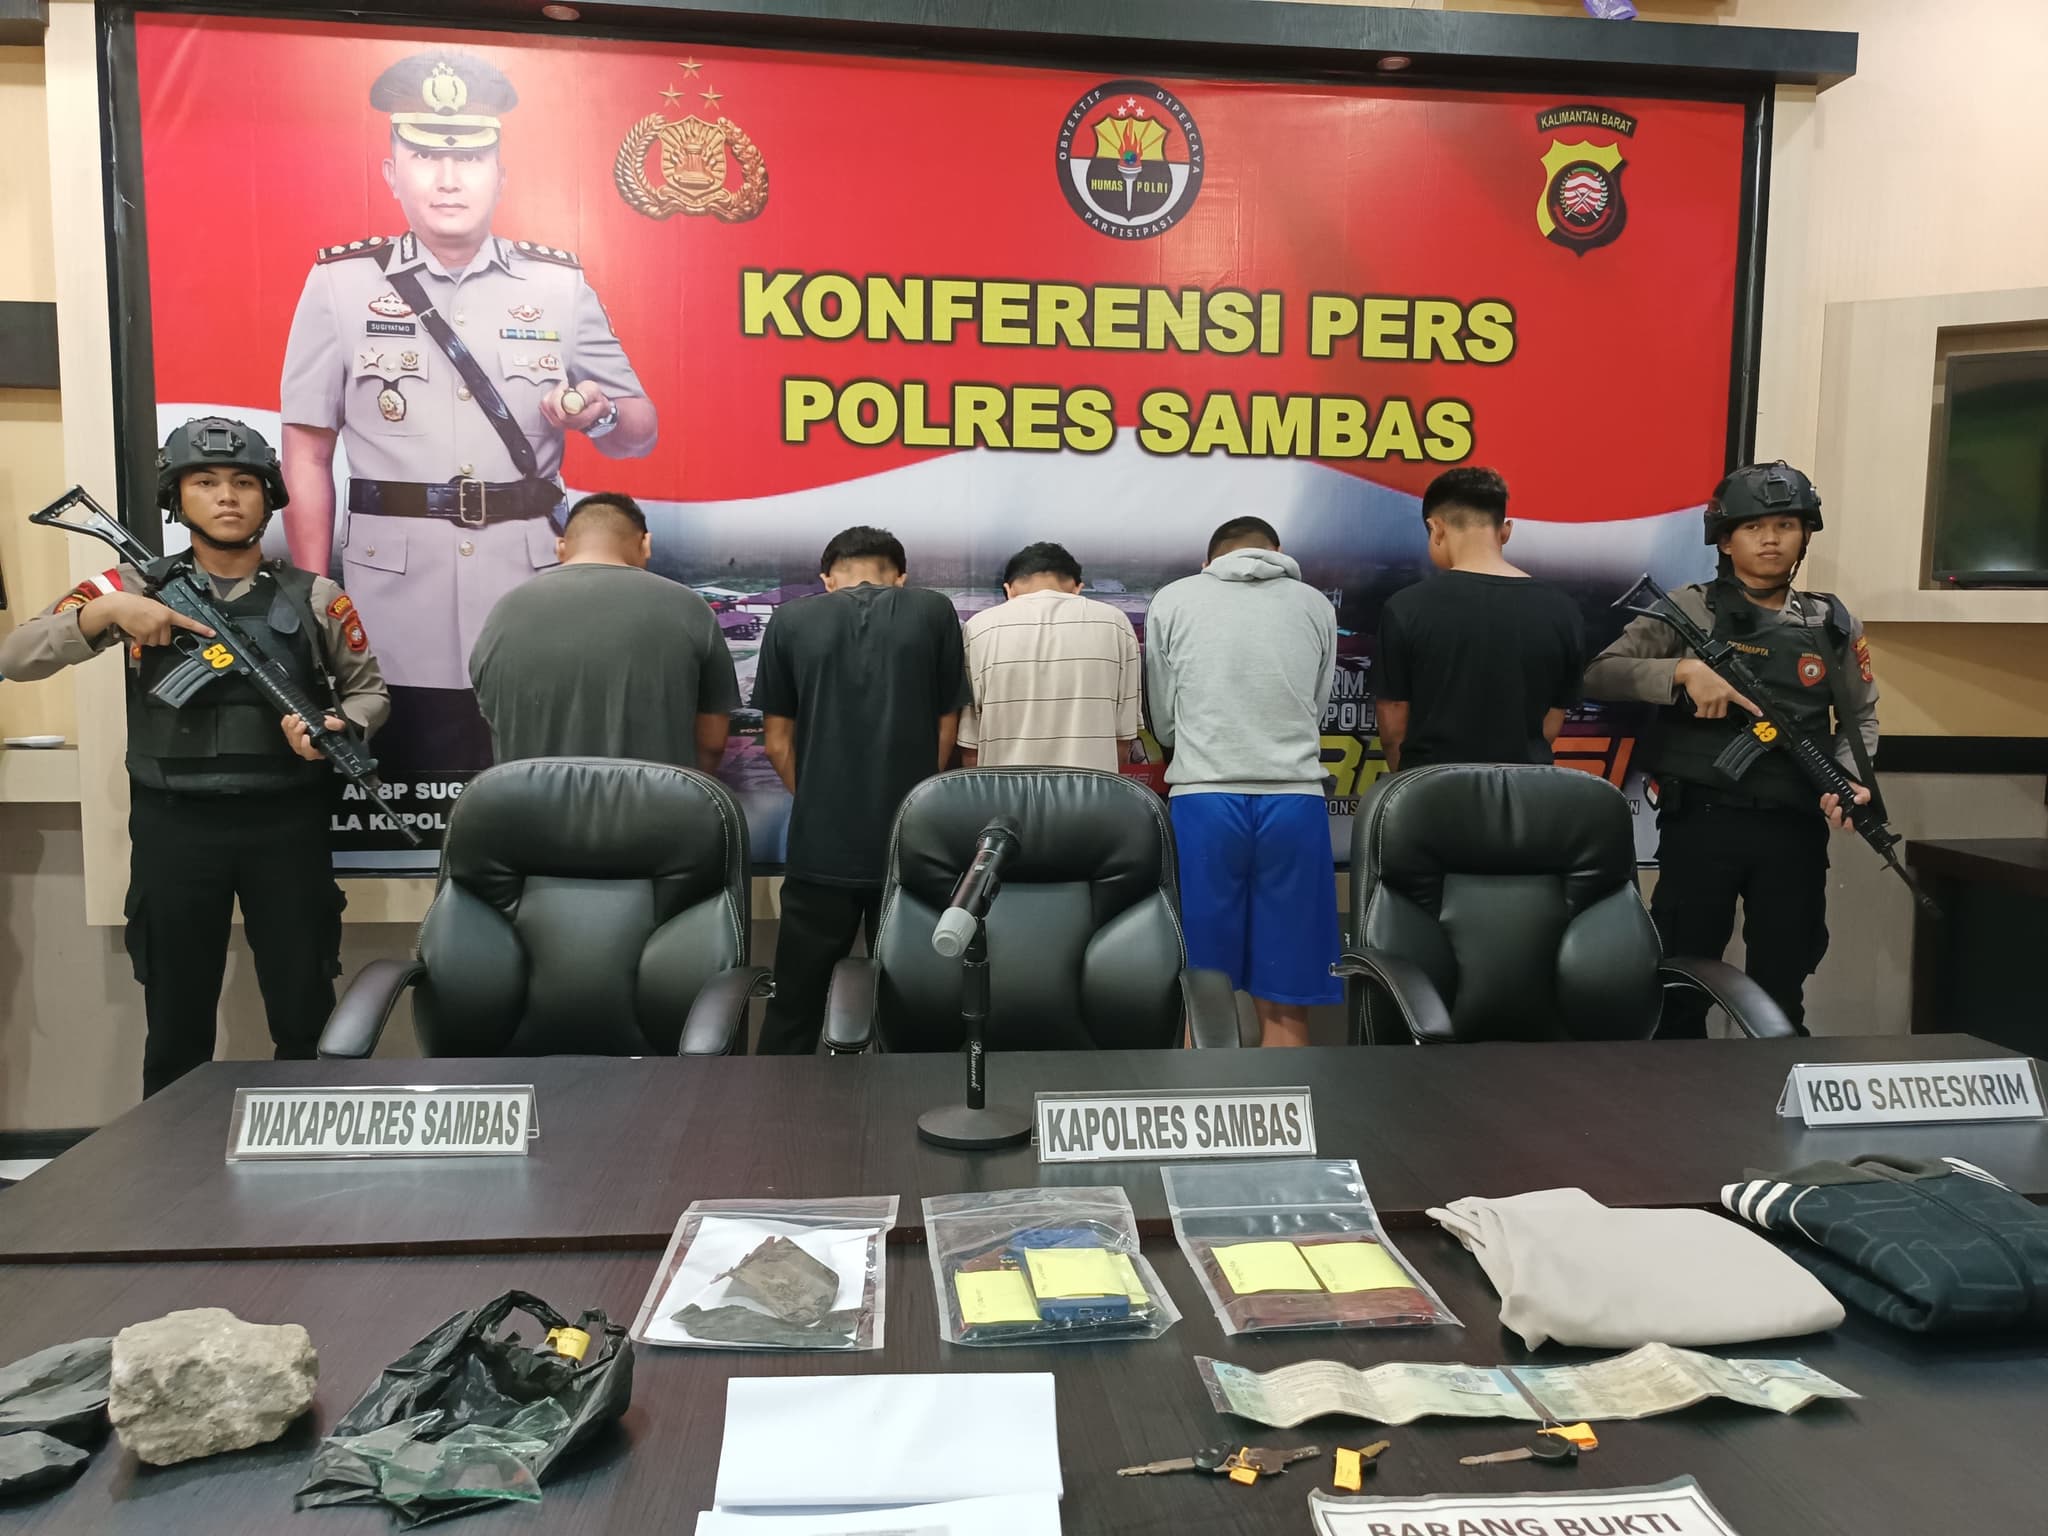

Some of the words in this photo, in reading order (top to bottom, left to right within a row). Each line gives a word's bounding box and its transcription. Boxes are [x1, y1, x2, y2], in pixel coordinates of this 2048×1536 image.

[1059, 90, 1101, 160] OBYEKTIF
[1156, 91, 1201, 174] DIPERCAYA
[1541, 110, 1599, 129] KALIMANTAN
[1601, 113, 1632, 133] BARAT
[1090, 178, 1124, 192] HUMAS
[1136, 181, 1168, 194] POLRI
[1084, 210, 1174, 238] PARTISIPASI
[742, 270, 1282, 355] KONFERENSI
[1310, 294, 1515, 363] PERS
[784, 378, 1115, 452] POLRES
[1138, 391, 1474, 462] SAMBAS
[202, 643, 234, 669] 50
[415, 782, 468, 800] SUG
[1807, 1078, 1861, 1112] KBO
[1868, 1072, 2030, 1110] SATRESKRIM
[246, 1100, 416, 1146] WAKAPOLRES
[421, 1099, 521, 1146] SAMBAS
[1047, 1105, 1189, 1152] KAPOLRES
[1194, 1102, 1302, 1149] SAMBAS
[1367, 1517, 1549, 1536] BARANG
[1554, 1513, 1683, 1536] BUKTI
